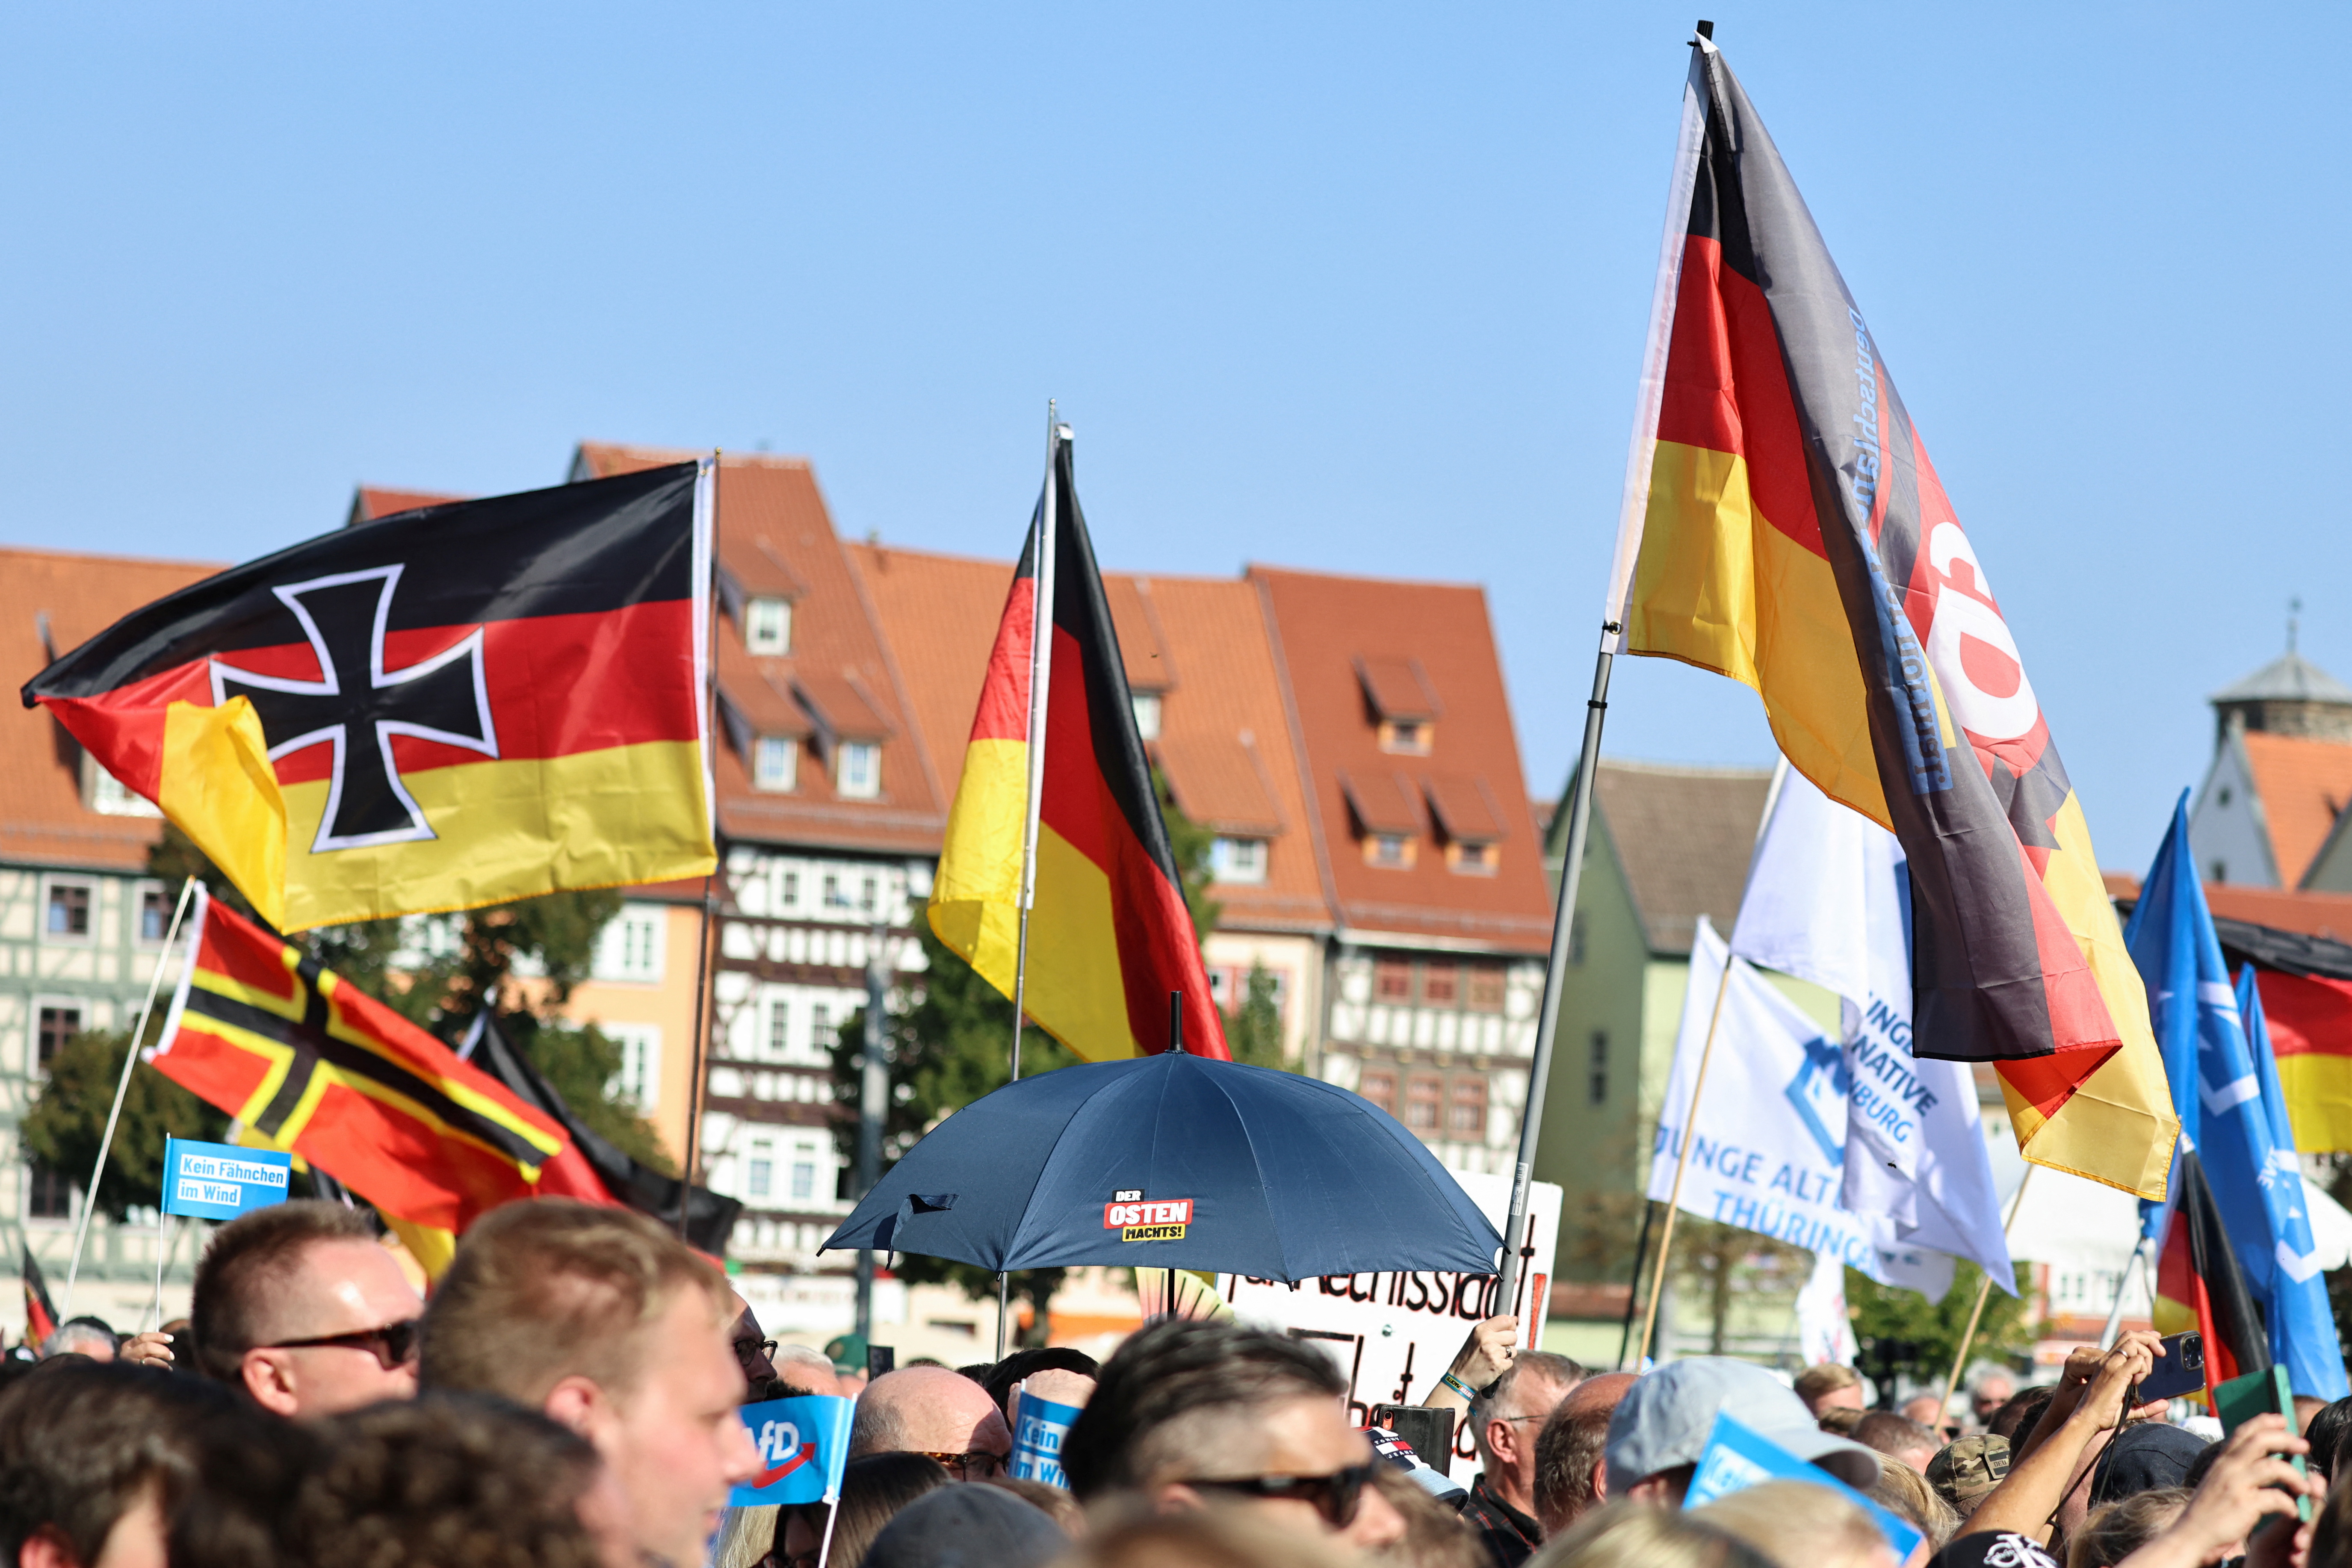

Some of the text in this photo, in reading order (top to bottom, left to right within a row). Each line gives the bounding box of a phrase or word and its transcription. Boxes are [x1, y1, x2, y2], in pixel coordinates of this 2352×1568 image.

[1851, 1034, 1938, 1117] NATIVE
[183, 1157, 284, 1184] Kein Fähnchen
[180, 1182, 238, 1203] im Wind
[1116, 1190, 1141, 1202] DER
[1109, 1202, 1188, 1225] OSTEN
[1125, 1226, 1182, 1240] MACHTS!
[1020, 1417, 1058, 1450] Kein
[1388, 1450, 1414, 1459] JEANS
